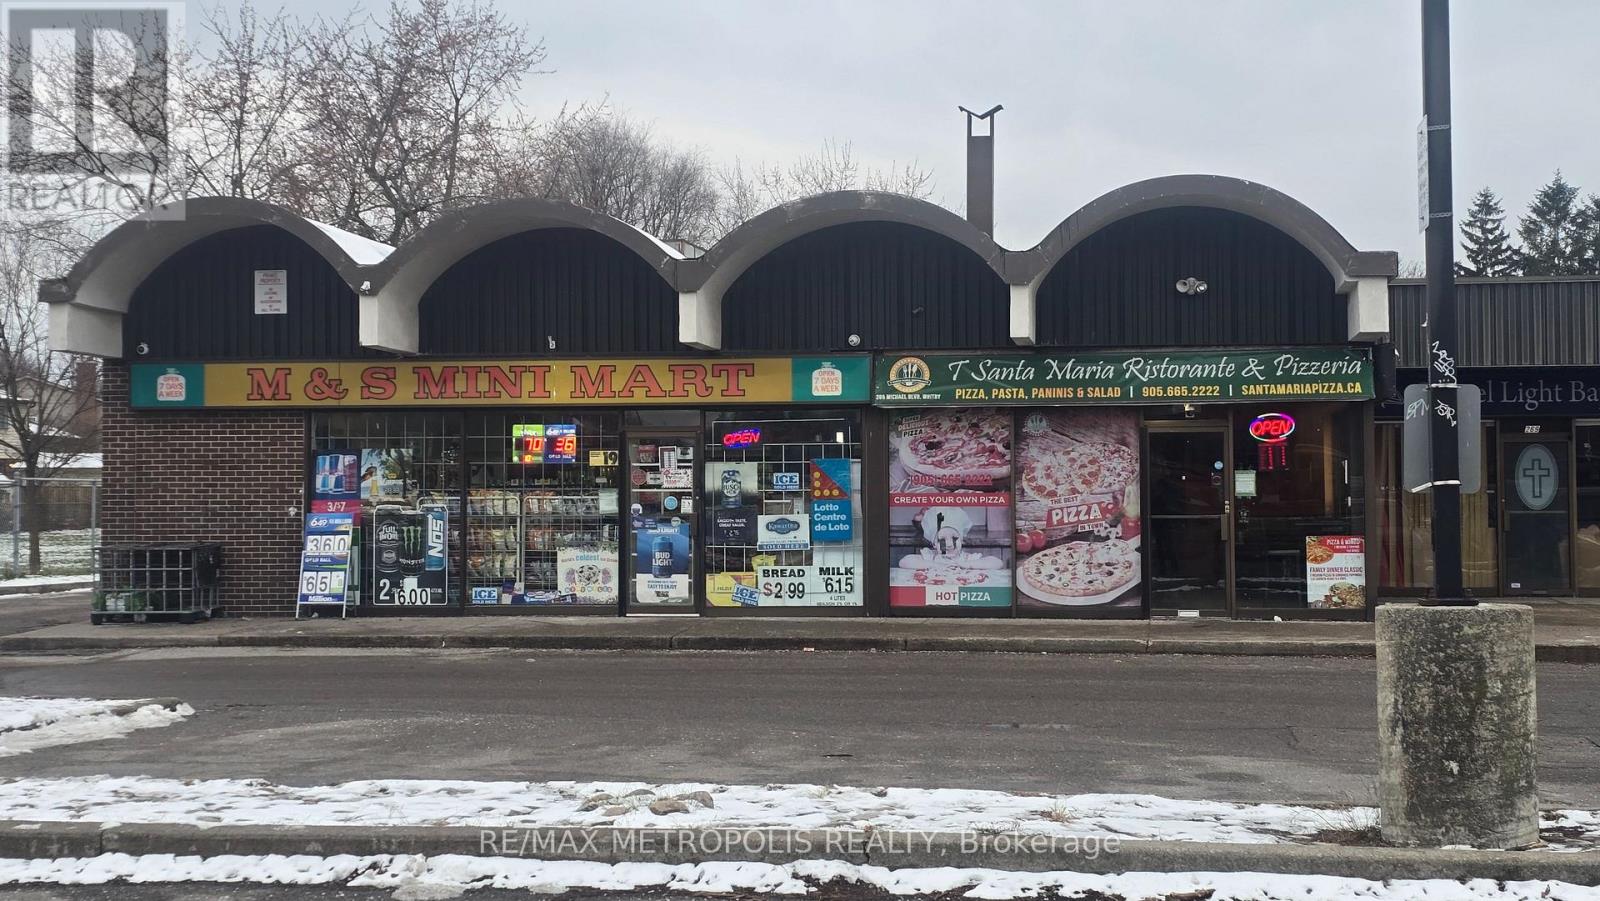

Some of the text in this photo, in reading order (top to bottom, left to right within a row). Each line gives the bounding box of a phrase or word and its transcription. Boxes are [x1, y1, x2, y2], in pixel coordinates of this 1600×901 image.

[949, 360, 969, 380] T
[971, 360, 1034, 381] Santa
[1044, 358, 1114, 380] Maria
[1122, 357, 1235, 382] Ristorante
[1242, 358, 1266, 380] &
[1274, 354, 1362, 376] Pizzeria
[247, 364, 754, 400] M & S MINI MART
[956, 382, 1362, 400] PIZZA, PASTA, PANINIS & SALAD 905.665.2222 SANTAMARIAPIZZA.CA
[1501, 380, 1562, 410] Light
[1252, 420, 1291, 436] OPEN
[723, 430, 760, 445] OPEN
[775, 475, 798, 484] ICE
[1052, 504, 1102, 524] PIZZA
[762, 568, 806, 578] BREAD
[818, 566, 854, 576] MILK
[380, 578, 390, 600] 2
[474, 590, 496, 598] ICE
[735, 586, 758, 600] ICE
[936, 592, 990, 600] HOT PIZZA
